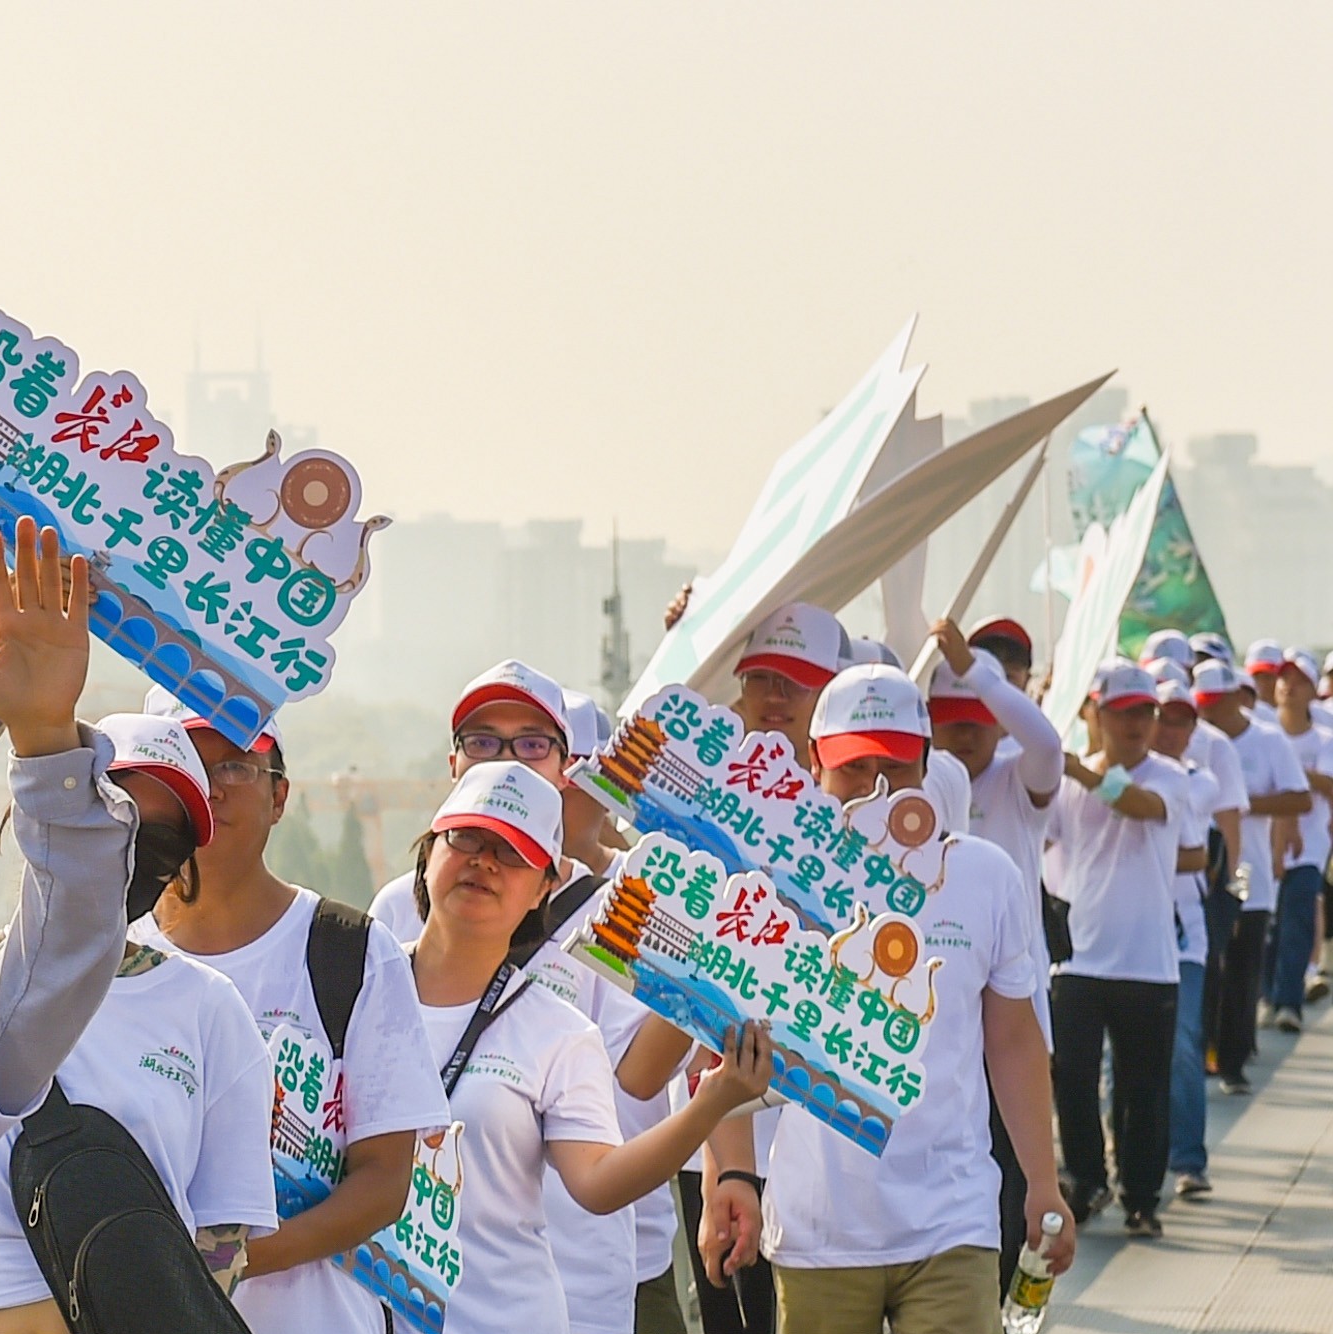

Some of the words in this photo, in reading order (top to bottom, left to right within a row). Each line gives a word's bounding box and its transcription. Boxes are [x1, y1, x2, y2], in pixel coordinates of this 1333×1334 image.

[6, 431, 332, 693] 湖北千里长江行
[640, 845, 921, 1054] 沿着长江读懂中国
[694, 778, 869, 922] 湖北千里长
